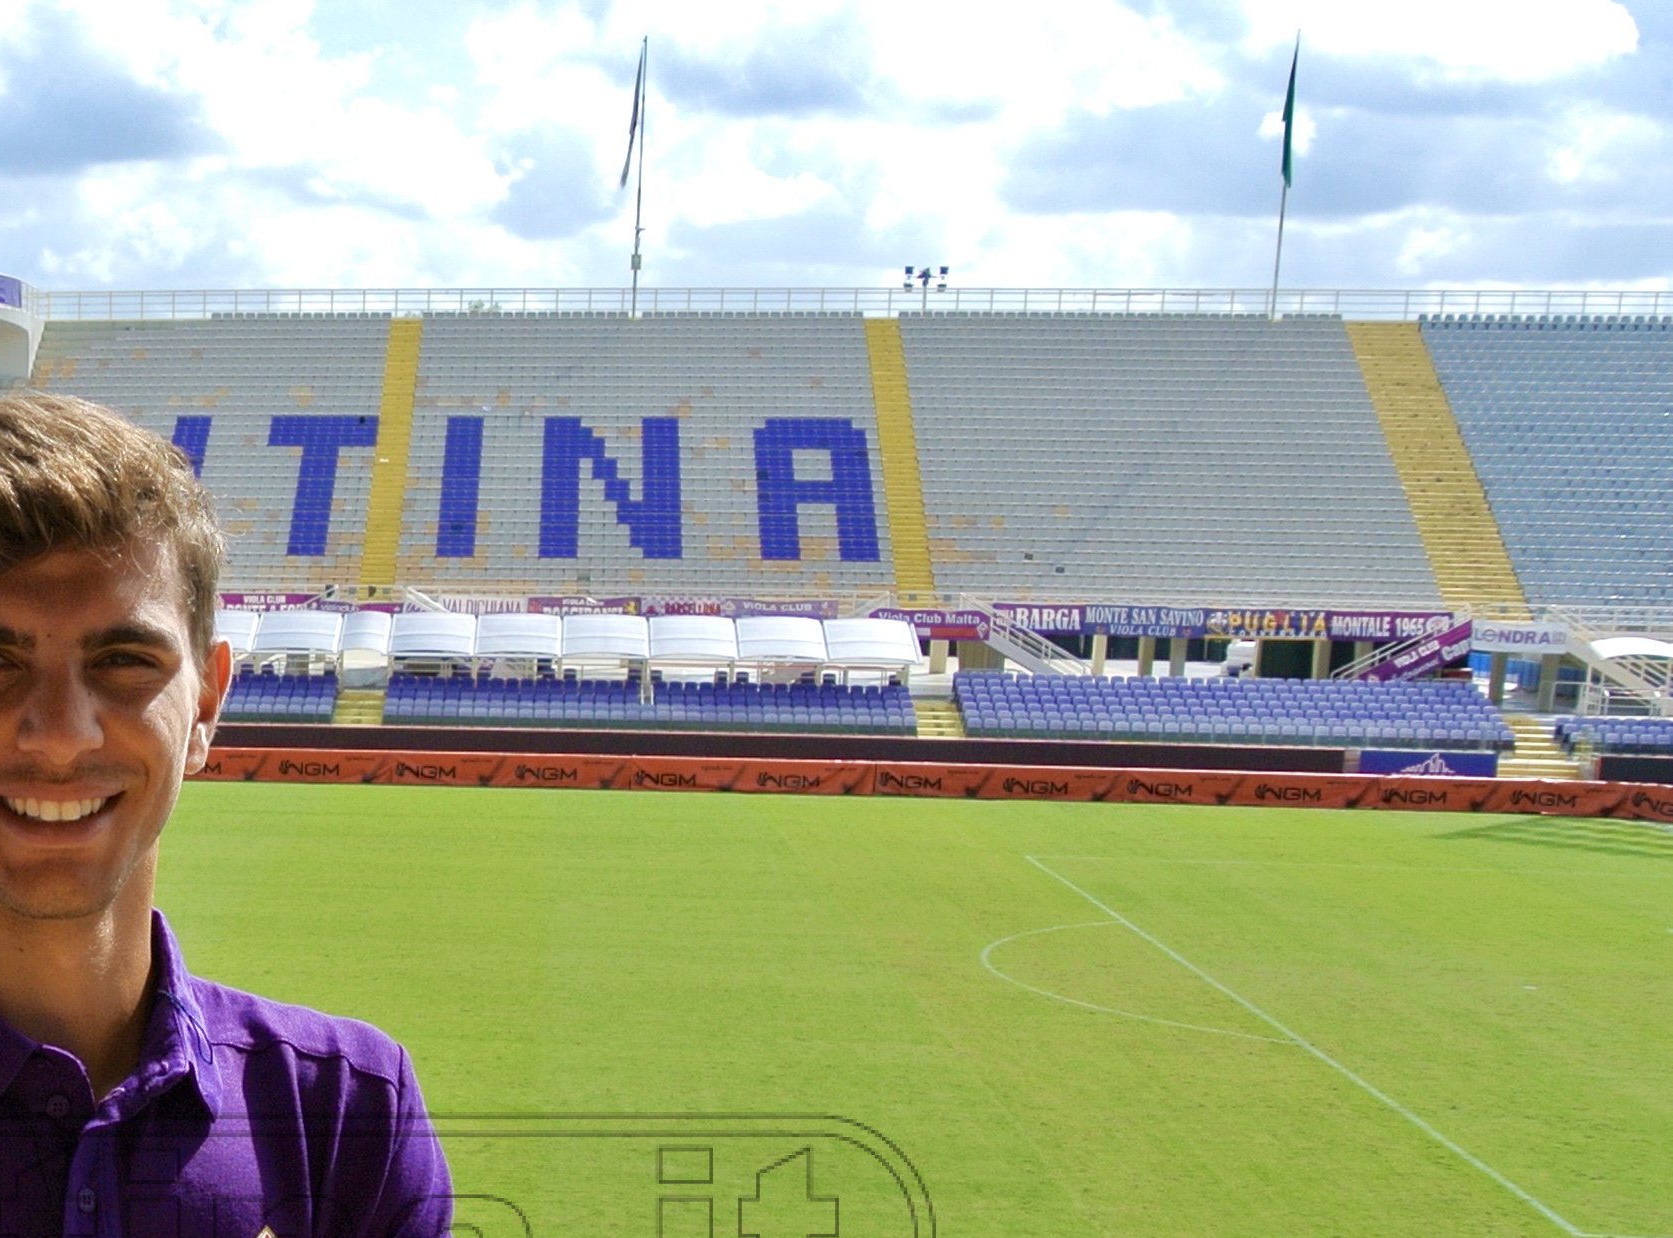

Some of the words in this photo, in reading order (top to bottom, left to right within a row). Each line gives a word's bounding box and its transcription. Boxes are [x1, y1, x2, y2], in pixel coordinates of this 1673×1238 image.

[243, 595, 265, 604] VIOLA
[267, 595, 286, 604] CLUB
[743, 602, 776, 612] VIOLA
[780, 603, 812, 612] CLUB
[878, 612, 910, 622] Viola
[914, 613, 941, 624] Club
[945, 613, 981, 625] Malta
[1016, 608, 1081, 630] BARGA
[1086, 606, 1128, 624] MONTE
[1131, 607, 1156, 625] SAN
[1160, 608, 1204, 626] SAVINO
[1229, 613, 1325, 632] PUGLIA
[1110, 625, 1143, 635] VIOLA
[1148, 626, 1177, 637] CLUB
[1331, 616, 1390, 637] MONTALE
[1395, 617, 1425, 637] 1965
[1474, 628, 1553, 645] LONDRA
[288, 762, 340, 776] NGM
[403, 765, 456, 779] NGM
[526, 767, 578, 781] NGM
[643, 773, 696, 787] NGM
[765, 774, 820, 788] NGM
[889, 776, 942, 790] NGM
[1014, 780, 1069, 794] NGM
[1137, 782, 1192, 798] NGM
[1264, 786, 1321, 801] NGM
[1391, 790, 1447, 805] NGM
[1521, 792, 1577, 807] NGM
